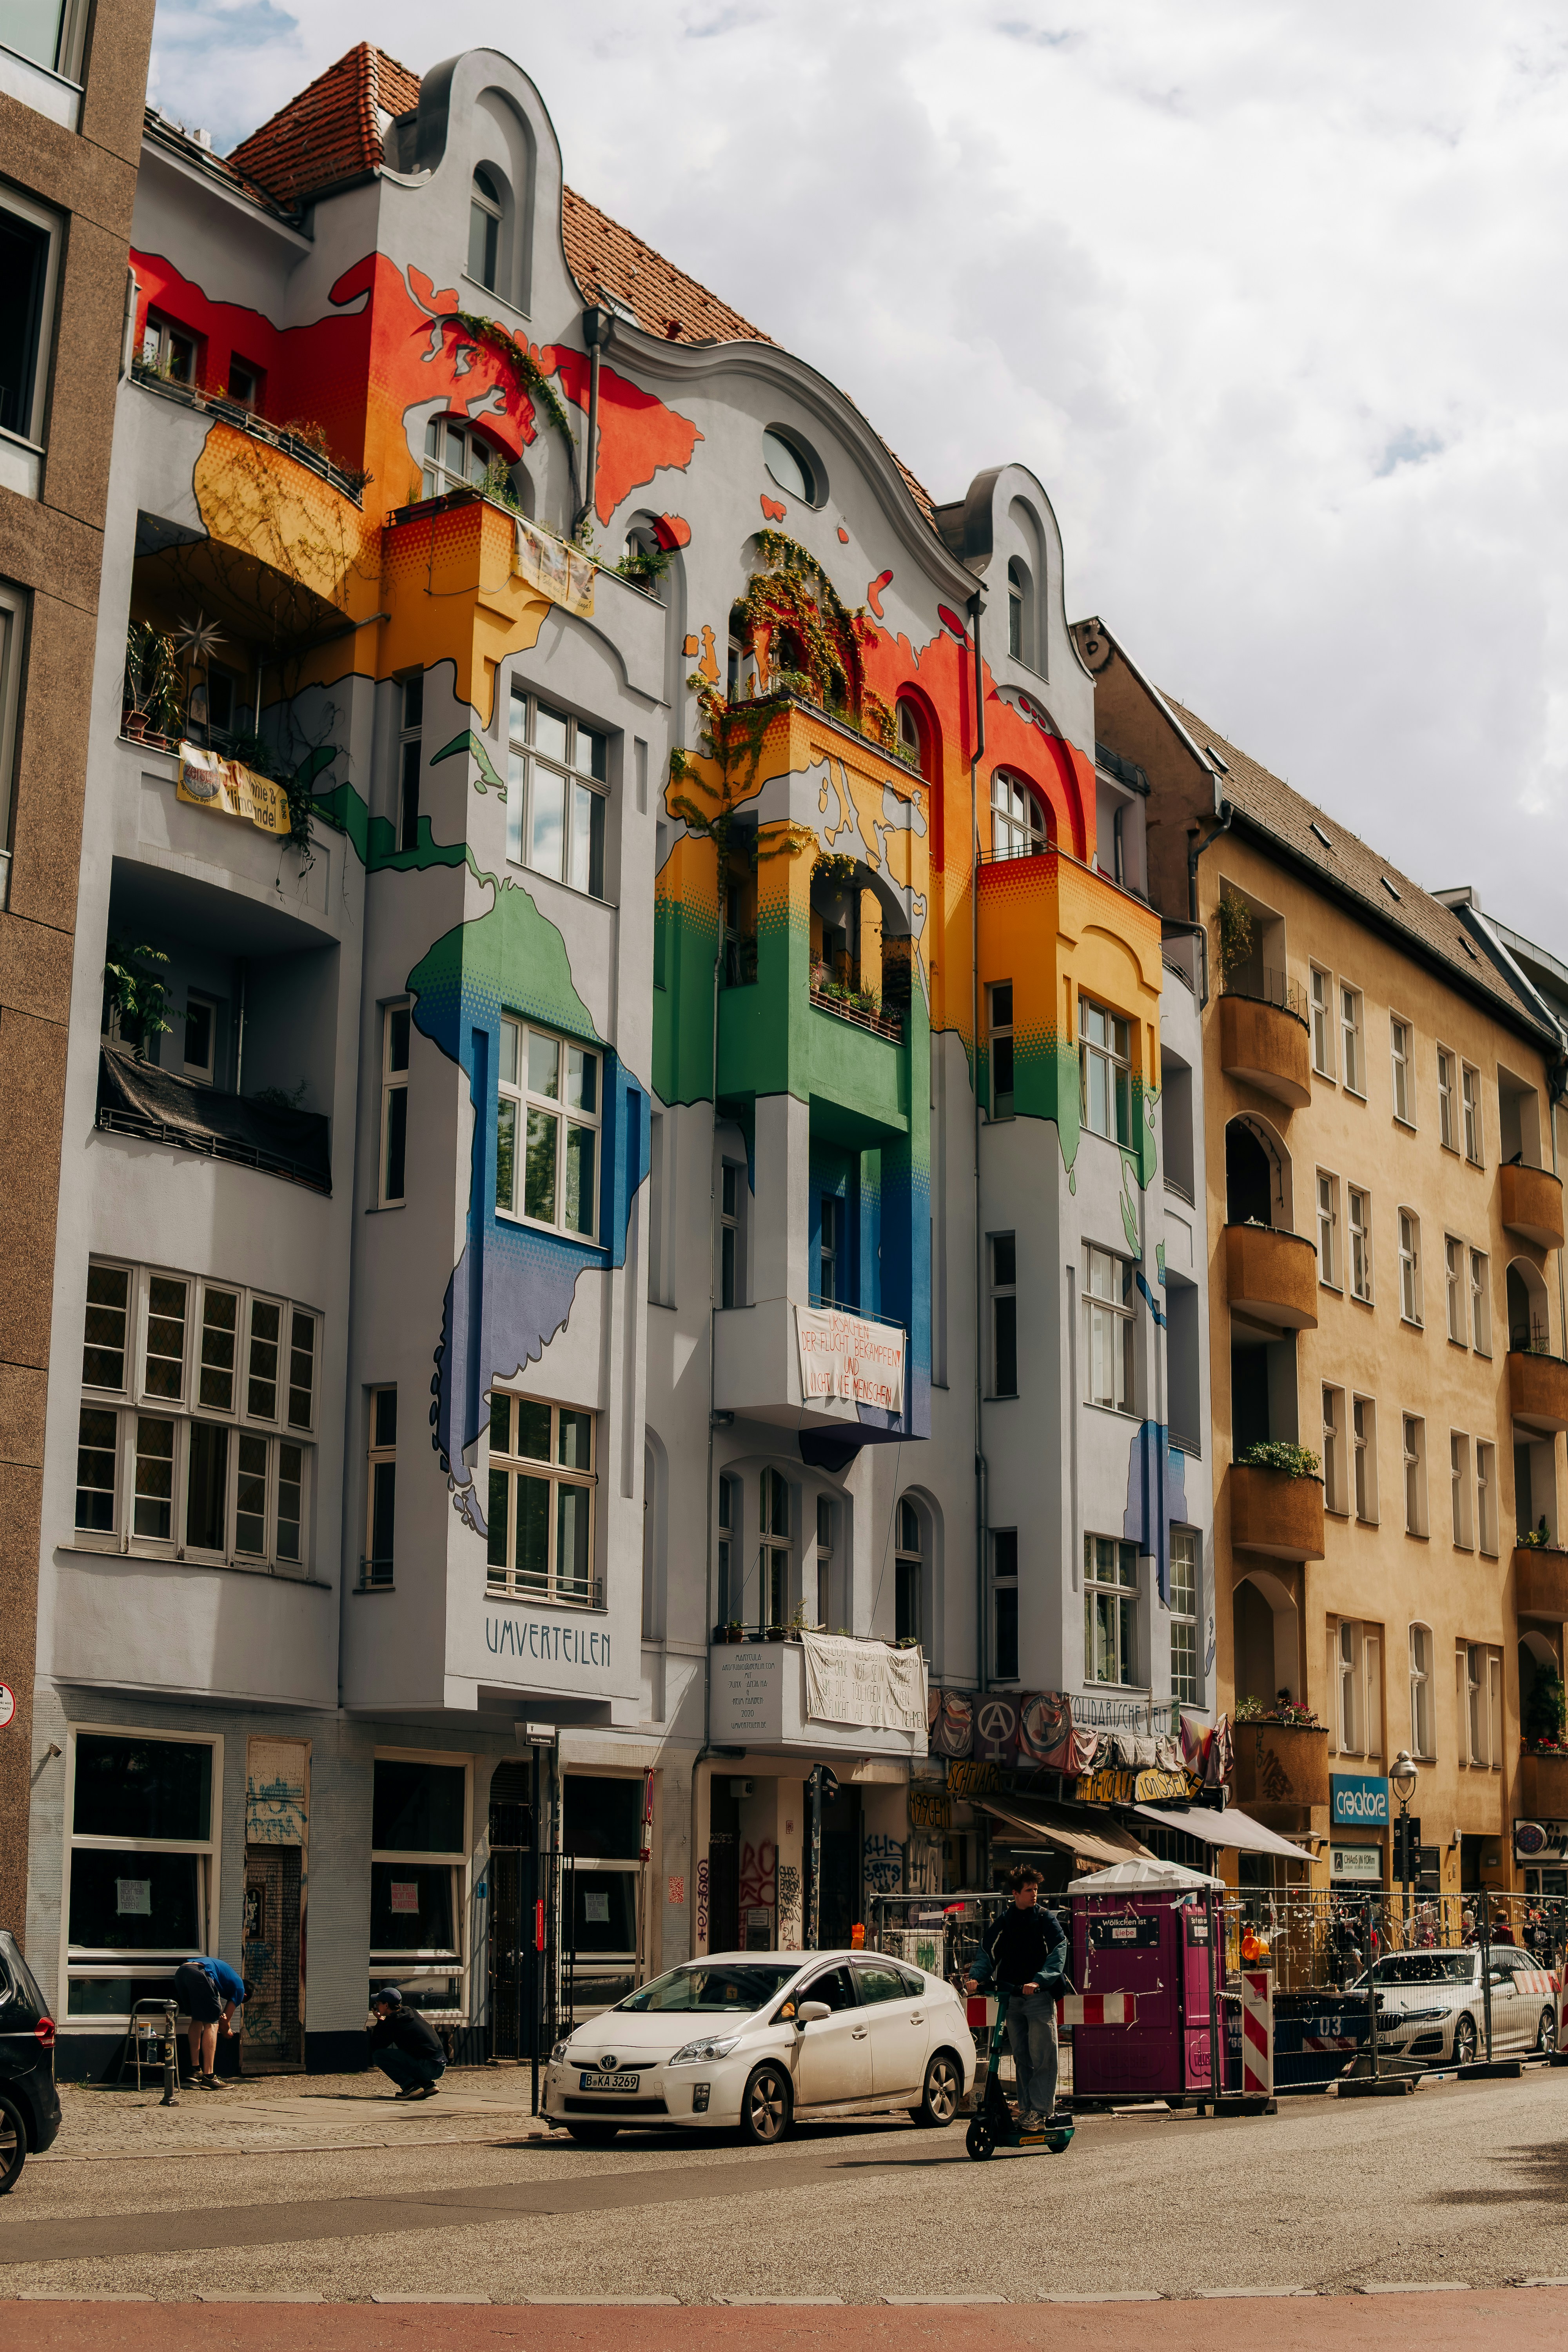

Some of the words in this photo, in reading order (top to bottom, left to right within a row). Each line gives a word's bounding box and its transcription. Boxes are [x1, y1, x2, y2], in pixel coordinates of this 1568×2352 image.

[829, 1312, 869, 1340] URSACHEN
[802, 1331, 816, 1352] DER
[820, 1332, 849, 1354] FLUCHT
[844, 1355, 859, 1376] UND
[809, 1372, 830, 1392] NICHT
[837, 1374, 849, 1394] DIE
[853, 1377, 891, 1406] MENSCHEN
[486, 1617, 610, 1667] UMVERTEILEN
[835, 1660, 848, 1677] OHNE
[855, 1664, 866, 1680] NOT
[871, 1664, 884, 1682] SEIN
[836, 1681, 846, 1698] DIE
[852, 1682, 881, 1702] TÖDLICHEN
[829, 1700, 849, 1719] FLUCHT
[855, 1704, 864, 1721] AUF
[889, 1708, 897, 1725] ZU
[902, 1710, 926, 1728] NEHMEN
[745, 1783, 752, 1794] 46
[1320, 2015, 1342, 2036] 03
[586, 2075, 592, 2086] B
[598, 2075, 610, 2087] KA
[612, 2076, 637, 2087] 3269
